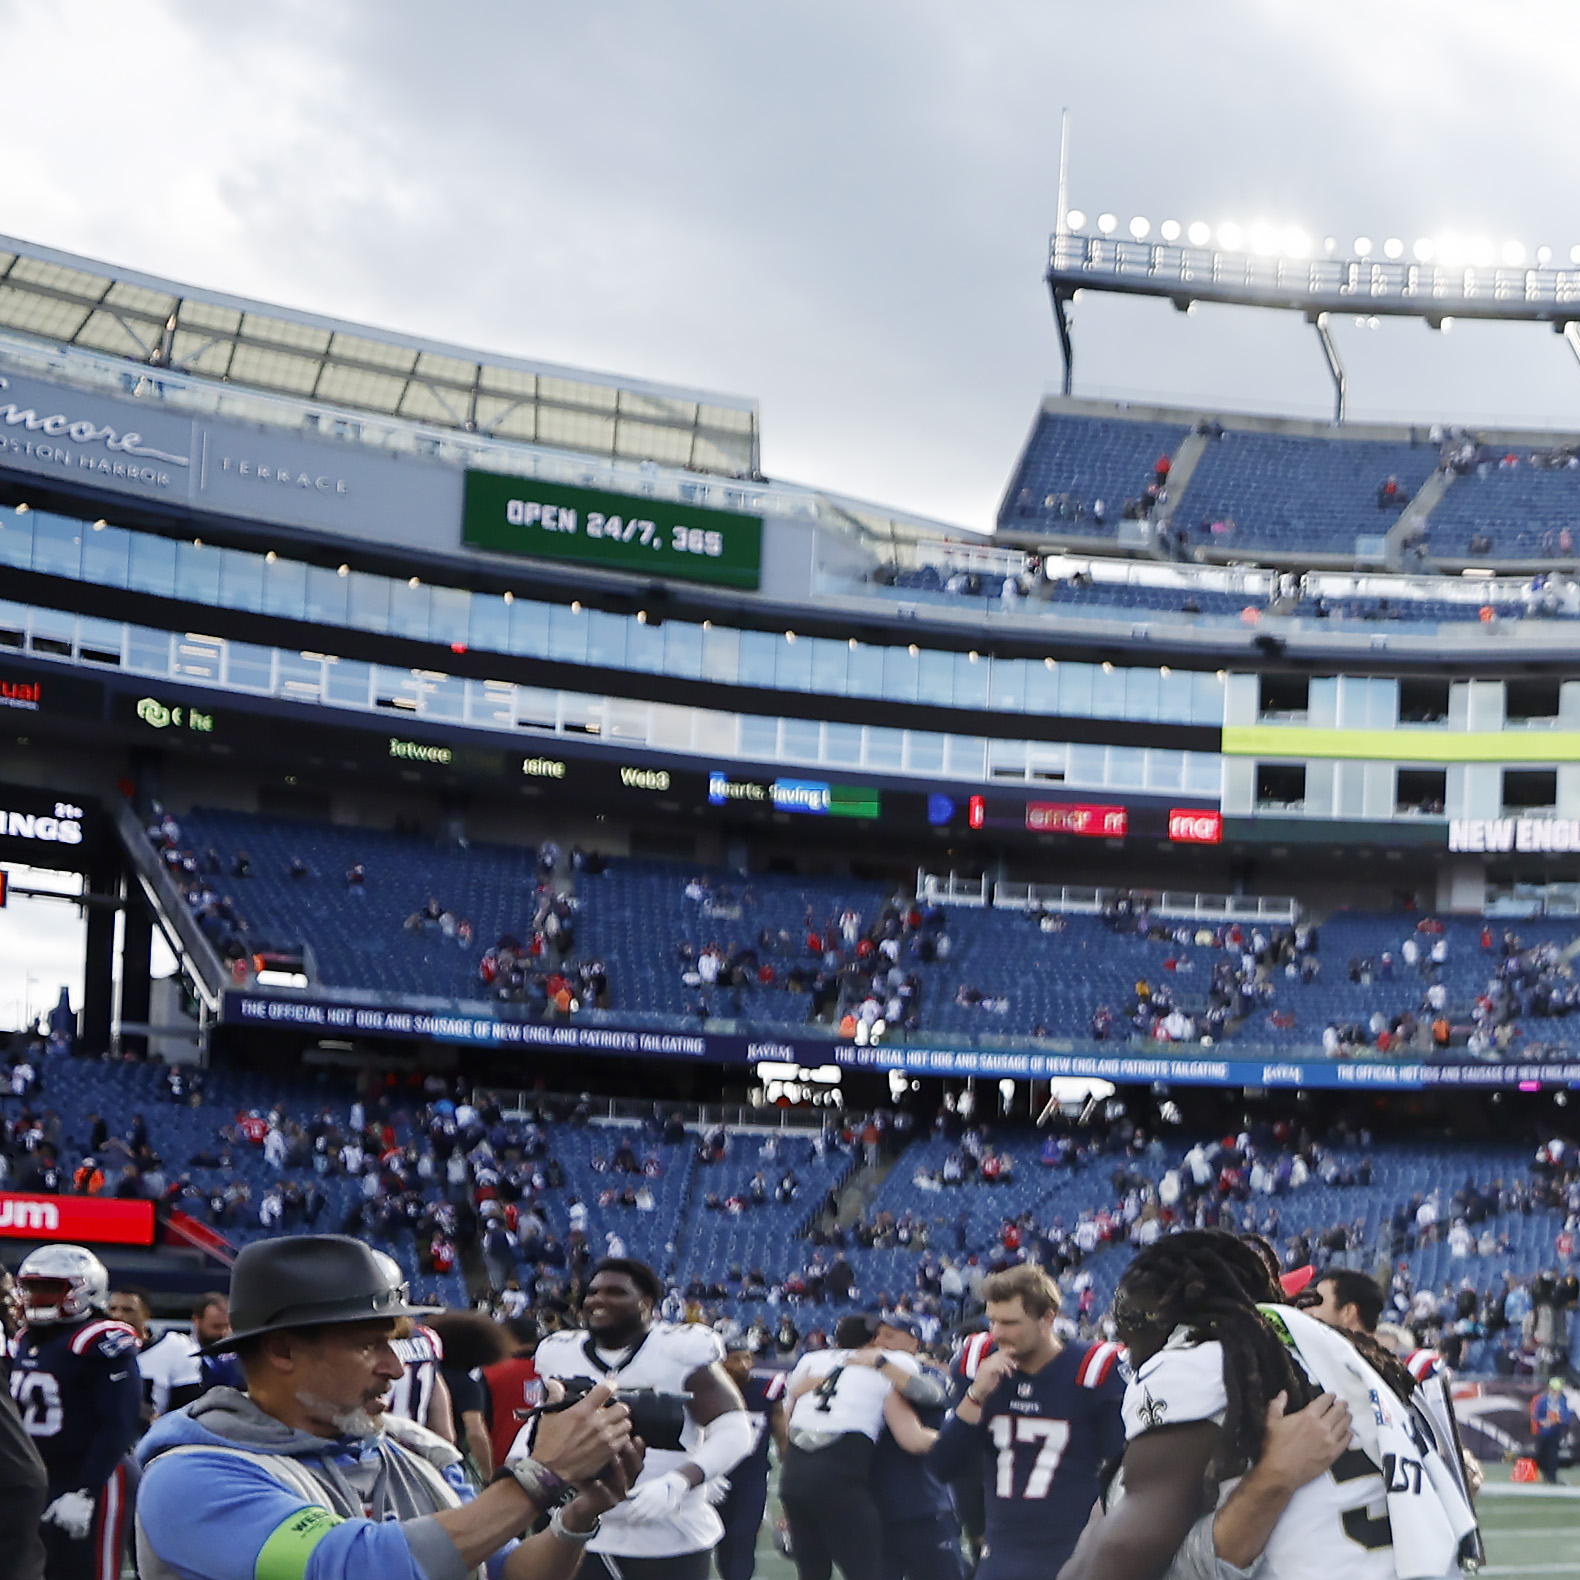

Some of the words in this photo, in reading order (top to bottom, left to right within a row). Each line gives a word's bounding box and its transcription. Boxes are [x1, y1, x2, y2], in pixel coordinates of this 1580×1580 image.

[0, 377, 190, 467] ncore
[79, 453, 170, 488] HARBOR
[506, 499, 577, 534] OPEN
[586, 511, 662, 550] 24/7,
[671, 525, 723, 557] 365
[1449, 819, 1514, 852] NEW
[834, 1046, 856, 1063] THE
[857, 1048, 904, 1066] OFFICIAL
[905, 1051, 929, 1067] HOT
[930, 1052, 953, 1068] DOG
[954, 1053, 977, 1070] AND
[979, 1054, 1029, 1072] SAUSAGE
[1030, 1056, 1045, 1072] OF
[1046, 1056, 1070, 1073] NEW
[1072, 1057, 1119, 1075] ENGLAND
[1120, 1060, 1168, 1077] PATRIOTS
[1170, 1061, 1229, 1078] TAILGATING
[1337, 1064, 1354, 1081] THE
[1355, 1065, 1398, 1083] OFFICIAL
[987, 1413, 1071, 1499] 17
